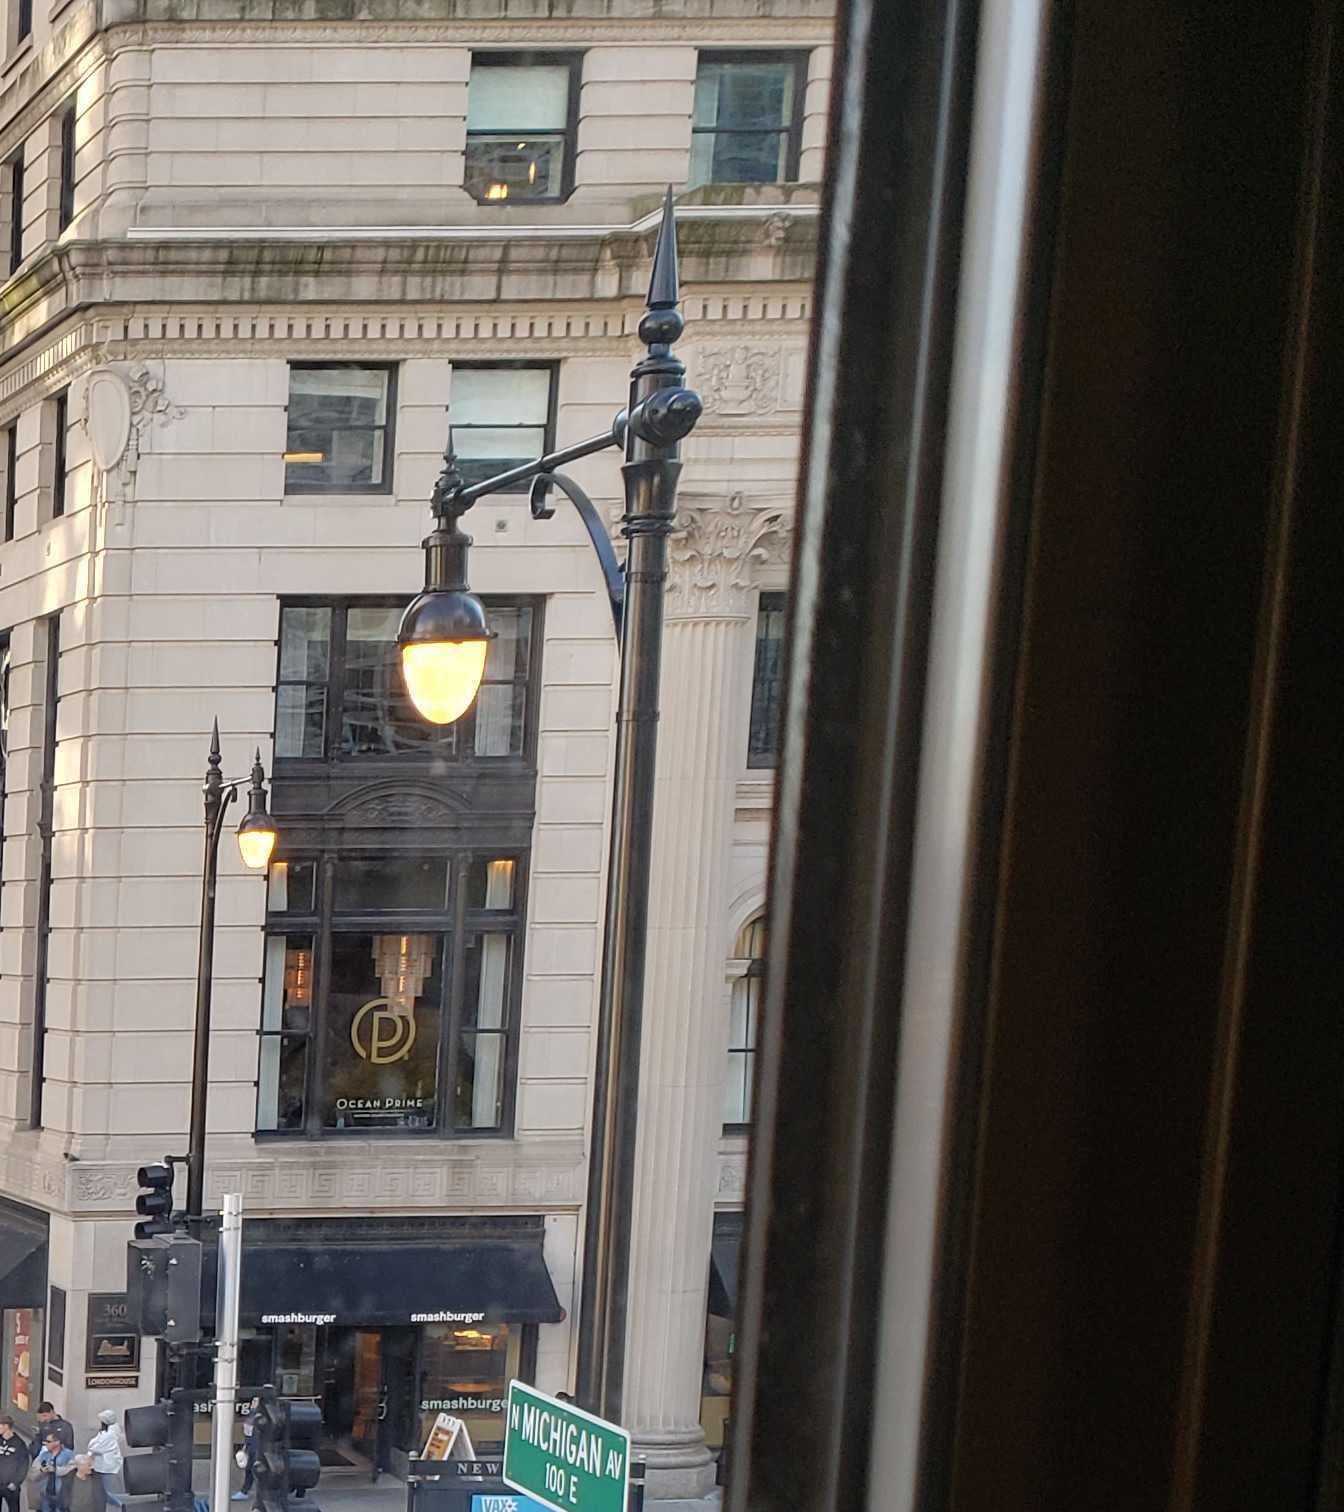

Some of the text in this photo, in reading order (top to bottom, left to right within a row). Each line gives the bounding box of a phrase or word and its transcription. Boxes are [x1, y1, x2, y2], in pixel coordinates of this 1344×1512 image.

[103, 1303, 128, 1317] 360
[261, 1312, 337, 1326] smashburger
[411, 1311, 484, 1324] smashburger
[511, 1402, 623, 1480] N MICHIGAN AV
[545, 1462, 578, 1504] 100 E
